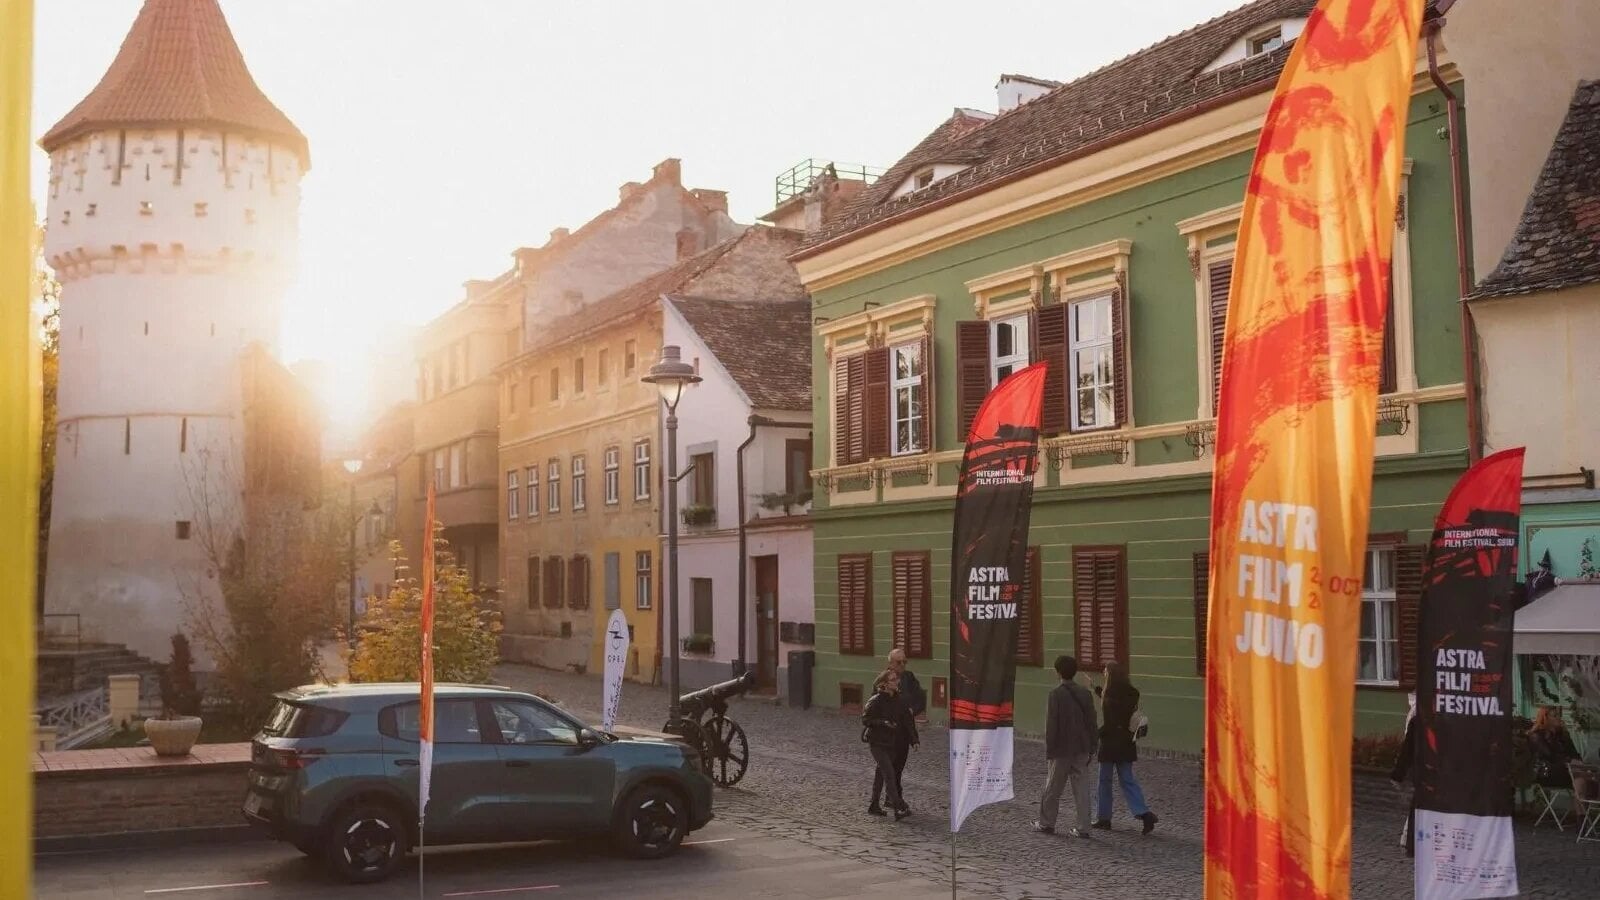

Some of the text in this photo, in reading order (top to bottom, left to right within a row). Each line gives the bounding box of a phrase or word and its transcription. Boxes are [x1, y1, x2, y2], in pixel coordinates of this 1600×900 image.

[976, 477, 992, 485] FILM
[1239, 499, 1318, 552] ASTR
[1444, 538, 1461, 548] FILM
[968, 566, 1009, 583] ASTRA
[1238, 554, 1303, 608] FILM
[968, 585, 1001, 601] FILM
[968, 602, 1018, 620] FESTIVA
[1436, 648, 1486, 670] ASTRA
[1436, 671, 1471, 692] FILM
